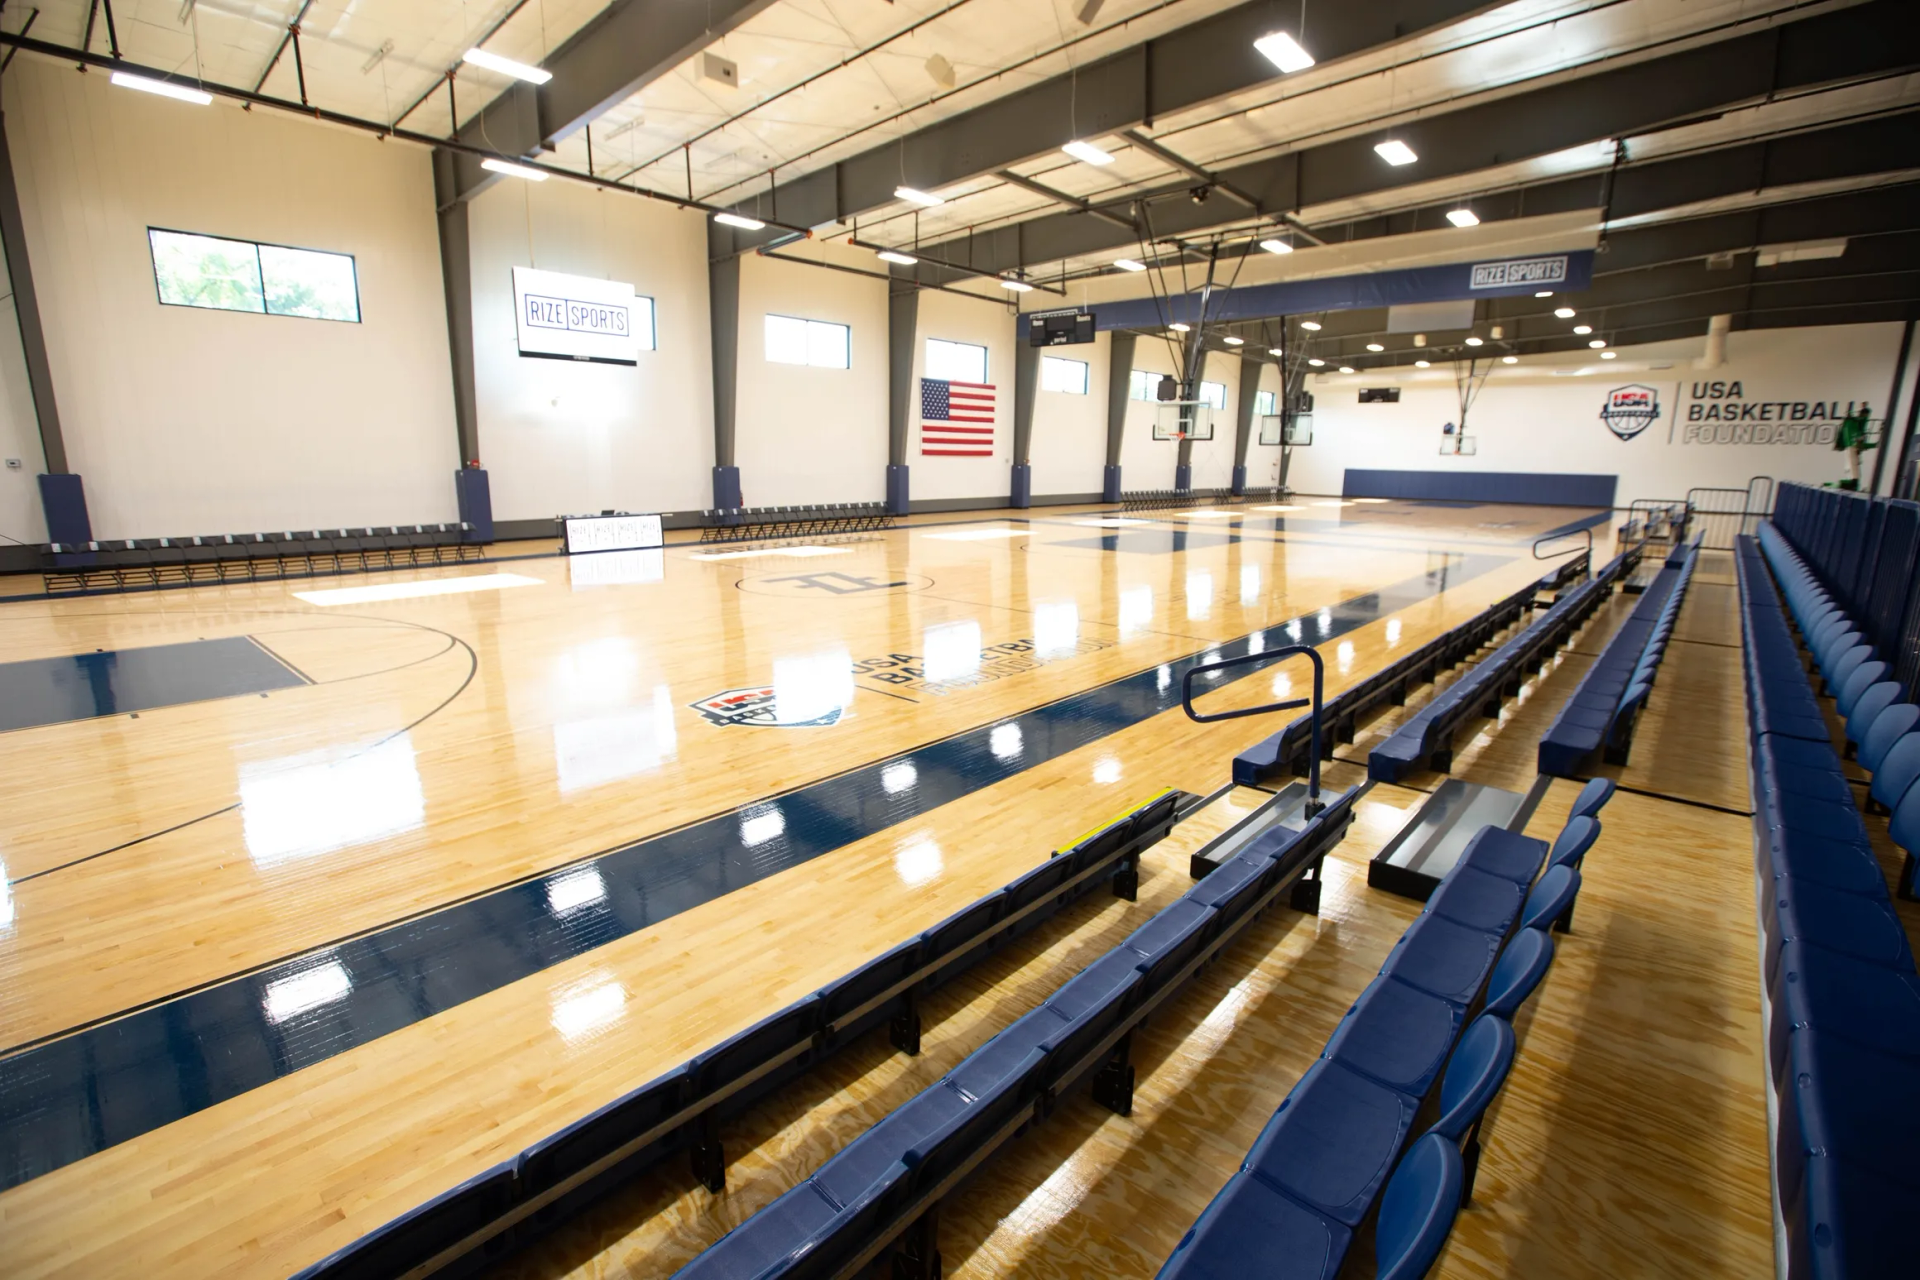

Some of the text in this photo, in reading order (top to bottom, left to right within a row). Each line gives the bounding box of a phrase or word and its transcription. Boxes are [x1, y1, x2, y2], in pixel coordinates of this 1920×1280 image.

[1475, 261, 1562, 284] RIZE SPORTS
[530, 301, 624, 330] RIZE SPORTS
[1691, 380, 1743, 399] USA
[1683, 422, 1842, 445] FOUNDATIO
